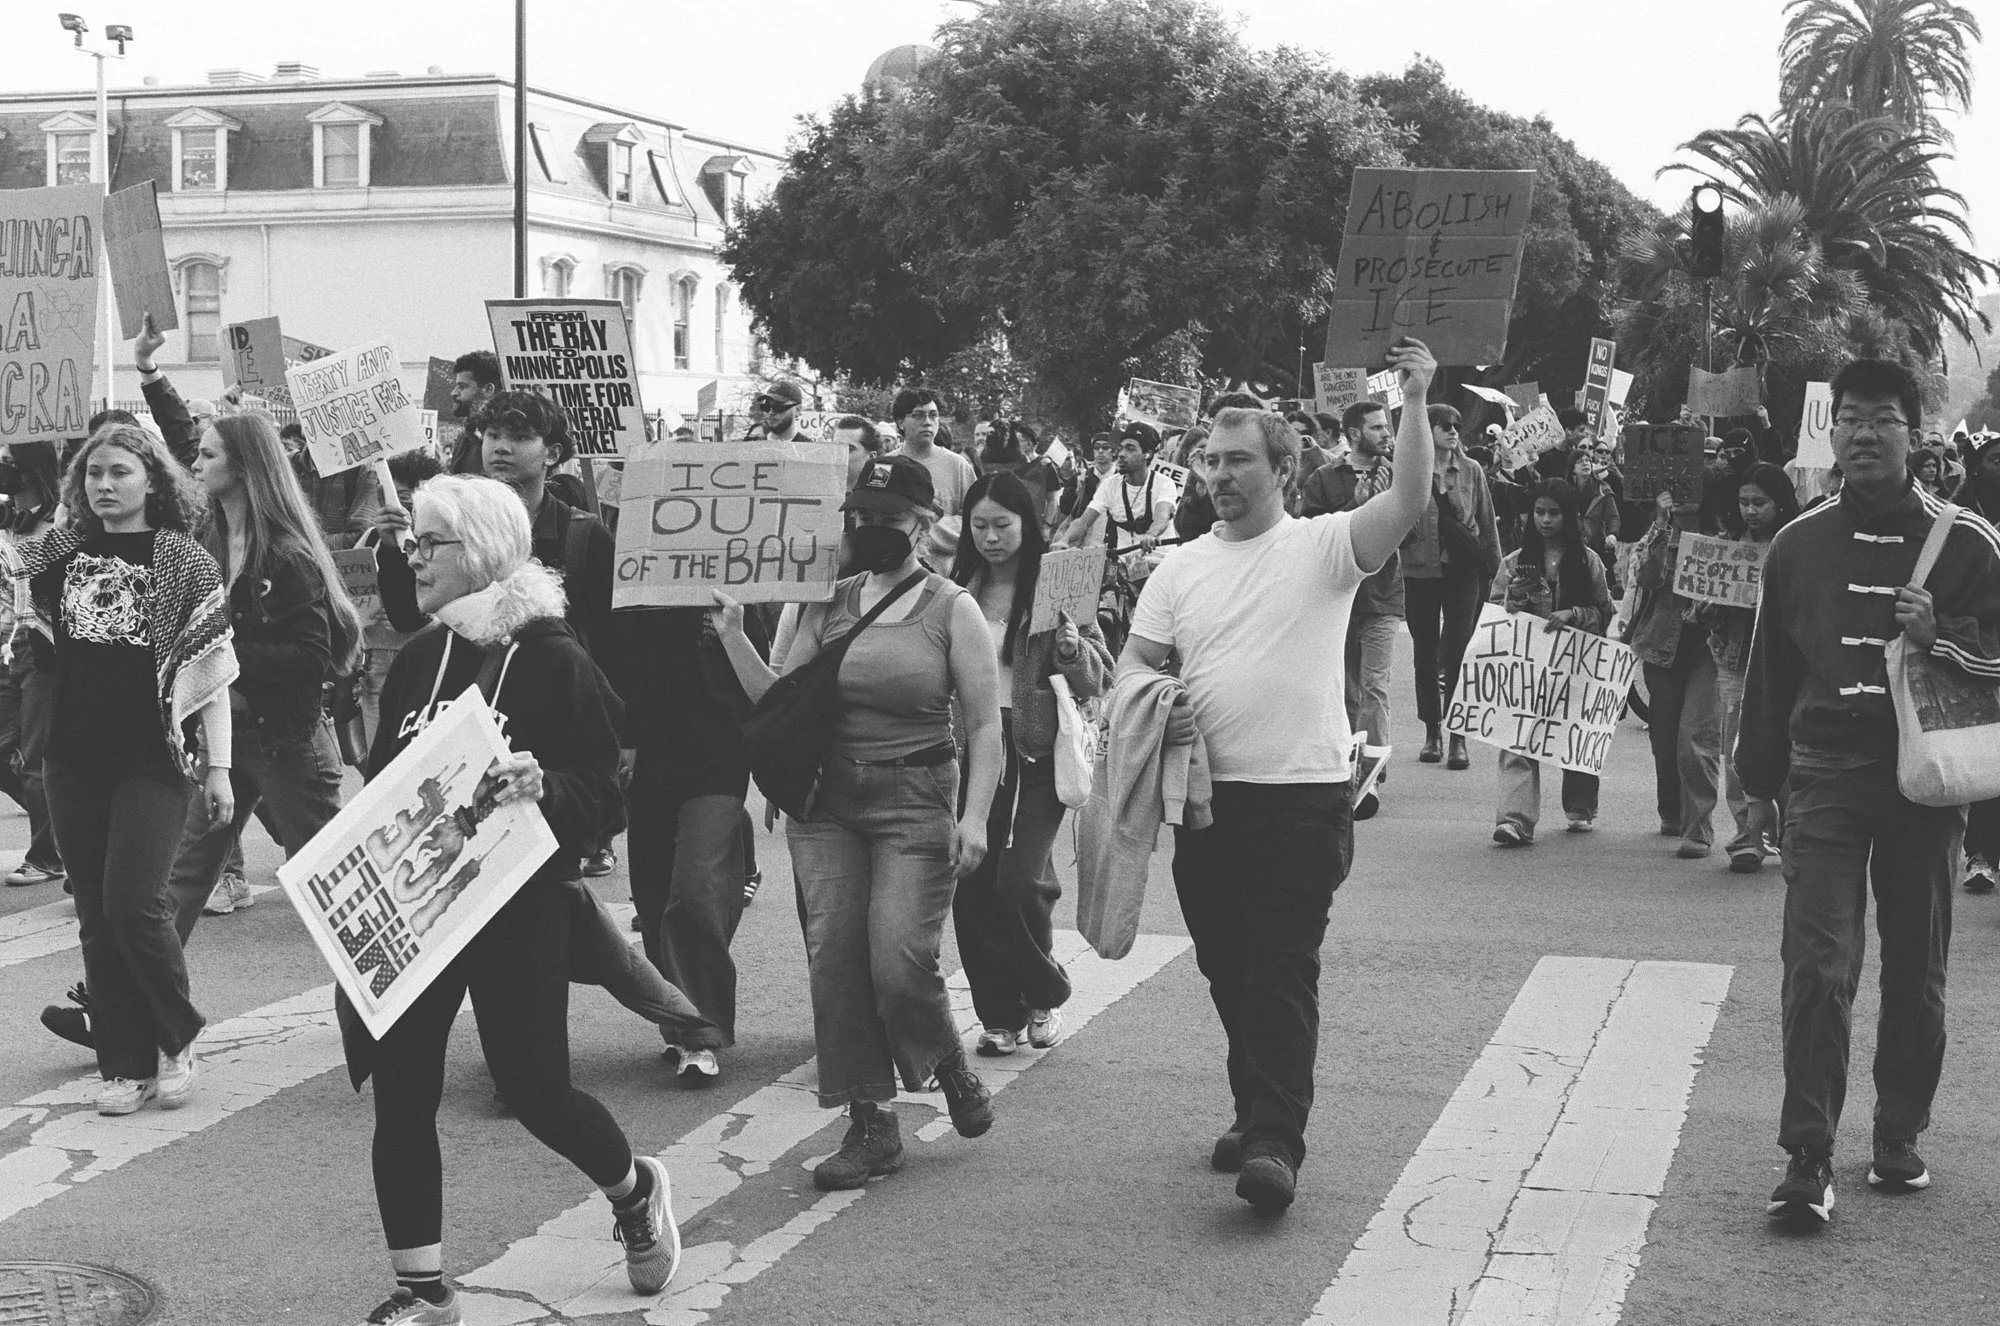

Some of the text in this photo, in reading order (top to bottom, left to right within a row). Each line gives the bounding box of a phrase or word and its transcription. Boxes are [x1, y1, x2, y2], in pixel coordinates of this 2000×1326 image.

[1358, 184, 1512, 232] ABOLISH
[0, 215, 93, 279] HINGA
[1354, 254, 1513, 286] PROSECUTE
[0, 291, 40, 353] A
[530, 312, 584, 322] FROM
[1361, 286, 1458, 332] ICE
[511, 319, 607, 351] THE BAY
[551, 349, 577, 357] TO
[1596, 344, 1608, 361] NO
[293, 359, 349, 405] LIBERTY
[358, 345, 393, 382] AND
[506, 355, 628, 380] MINNEAPOLIS
[1590, 363, 1608, 377] KINGS
[0, 357, 84, 435] GRA
[300, 377, 410, 444] JUSTICE FOR
[547, 383, 594, 407] TIME
[595, 382, 634, 407] FOR
[565, 407, 626, 431] NERAL
[341, 429, 383, 466] ALL
[572, 430, 618, 454] RIKE!
[671, 462, 779, 492] ICE
[652, 497, 822, 537] OUT
[618, 535, 817, 585] OF THE BAY
[1683, 556, 1760, 583] PEOPLE
[1679, 574, 1731, 598] MELT
[1476, 619, 1639, 687] I'LL TAKE MY
[1462, 661, 1626, 727] HORCHATA WARM
[1446, 702, 1496, 738] BEC
[1509, 713, 1562, 757] ICE
[365, 776, 482, 938] ICE
[307, 844, 421, 1000] MELT
